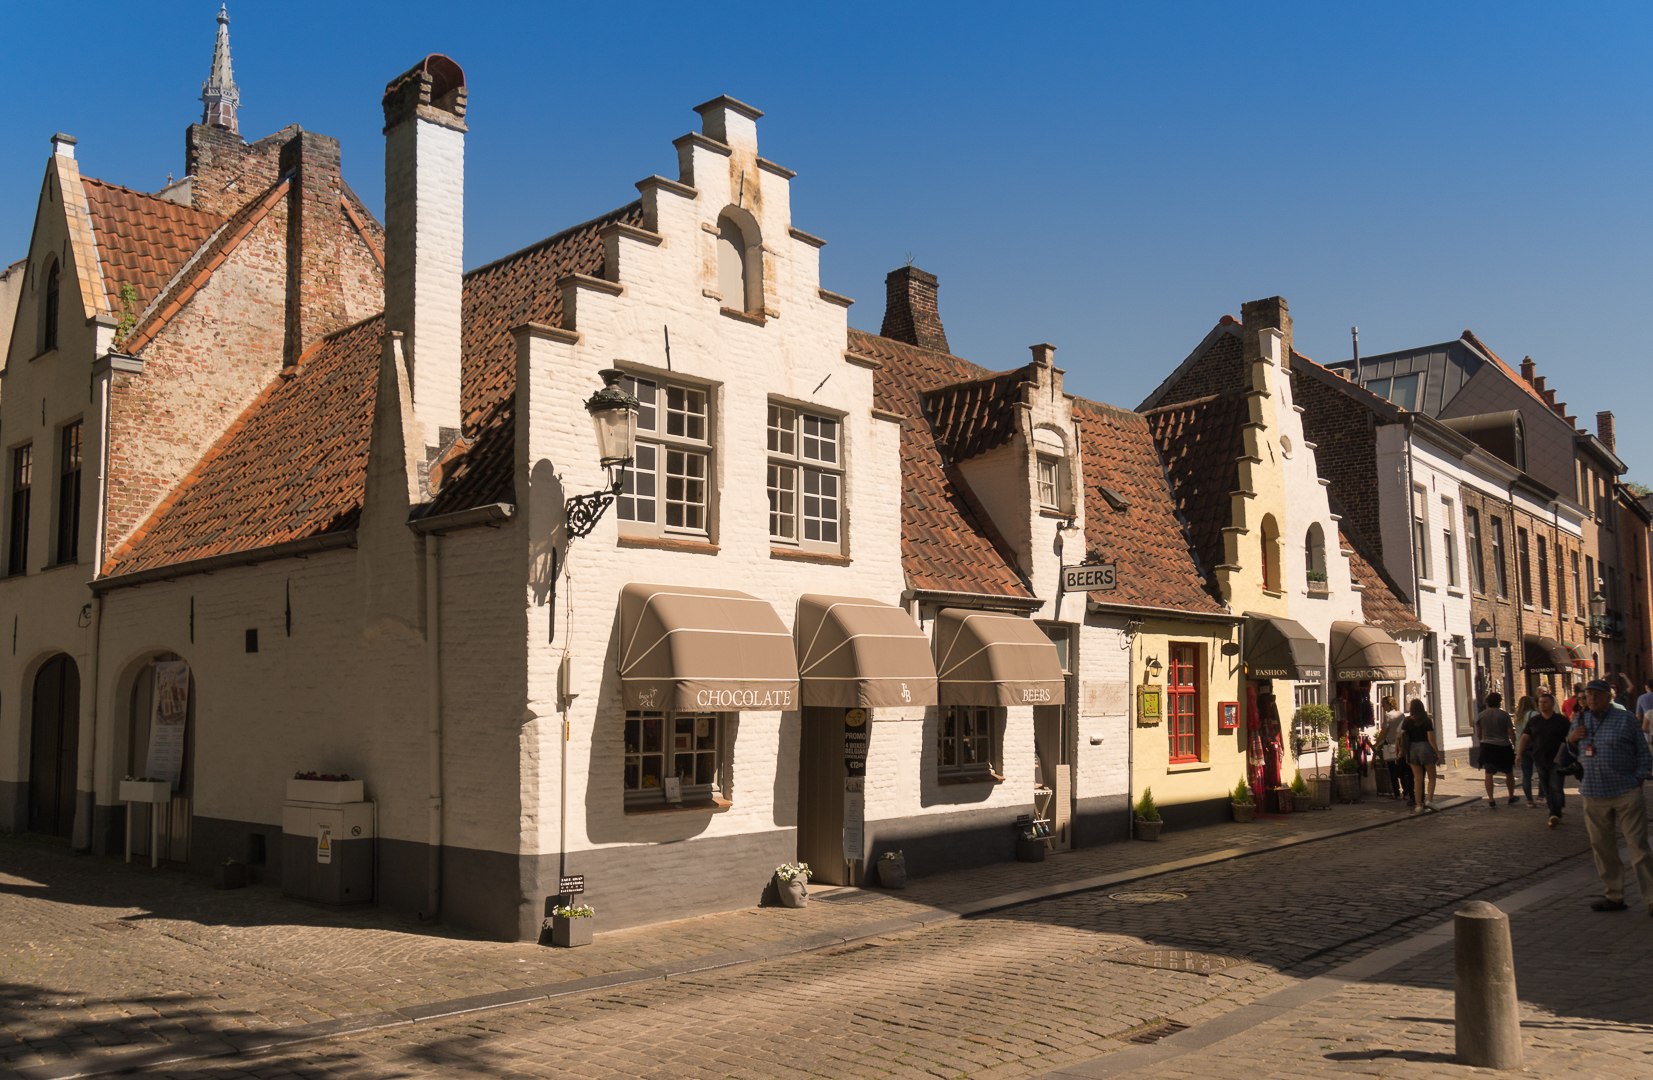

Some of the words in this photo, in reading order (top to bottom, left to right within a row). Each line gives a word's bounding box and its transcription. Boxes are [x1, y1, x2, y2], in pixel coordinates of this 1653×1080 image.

[1067, 570, 1113, 586] BEERS
[696, 689, 791, 706] CHOCOLATE
[1022, 689, 1050, 702] BEERS
[845, 732, 866, 740] PROMO
